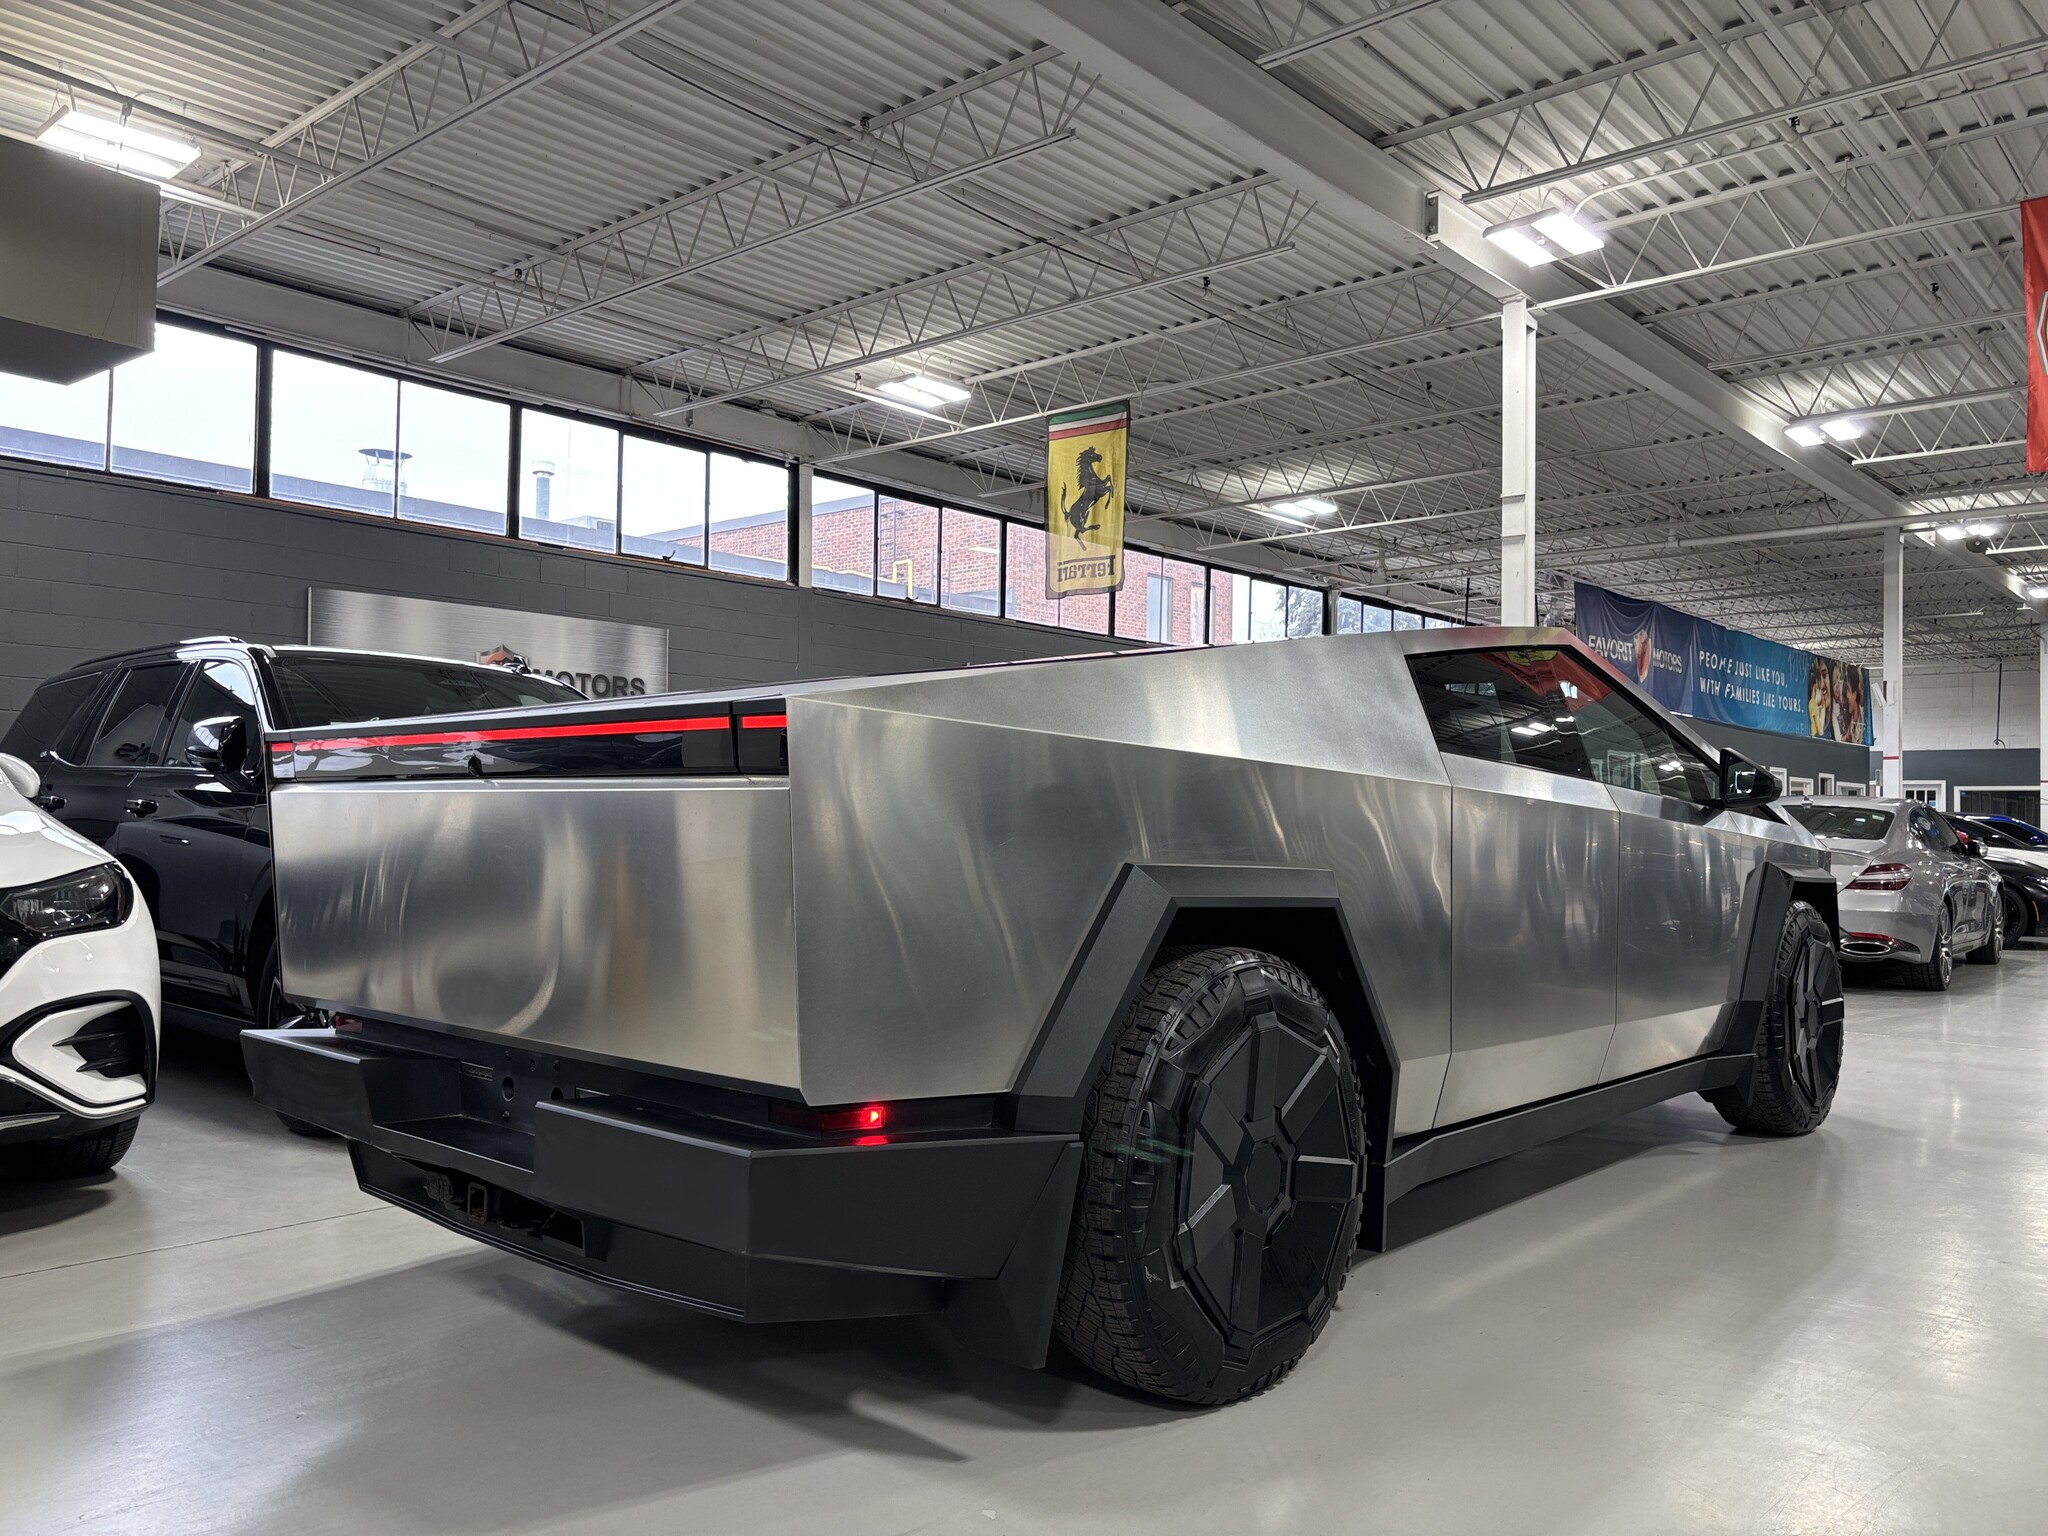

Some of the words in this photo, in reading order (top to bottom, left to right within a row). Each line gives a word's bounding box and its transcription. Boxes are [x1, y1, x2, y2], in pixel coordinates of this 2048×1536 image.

[1588, 635, 1633, 662] FAVORIT
[1653, 648, 1683, 674] MOTORS
[1735, 660, 1752, 679] JUST
[1755, 665, 1770, 682] LIKE
[1699, 677, 1721, 697] WITH
[1724, 683, 1760, 705] FAMILIES
[1762, 692, 1775, 708] LIKE
[1778, 695, 1805, 713] YOURS.
